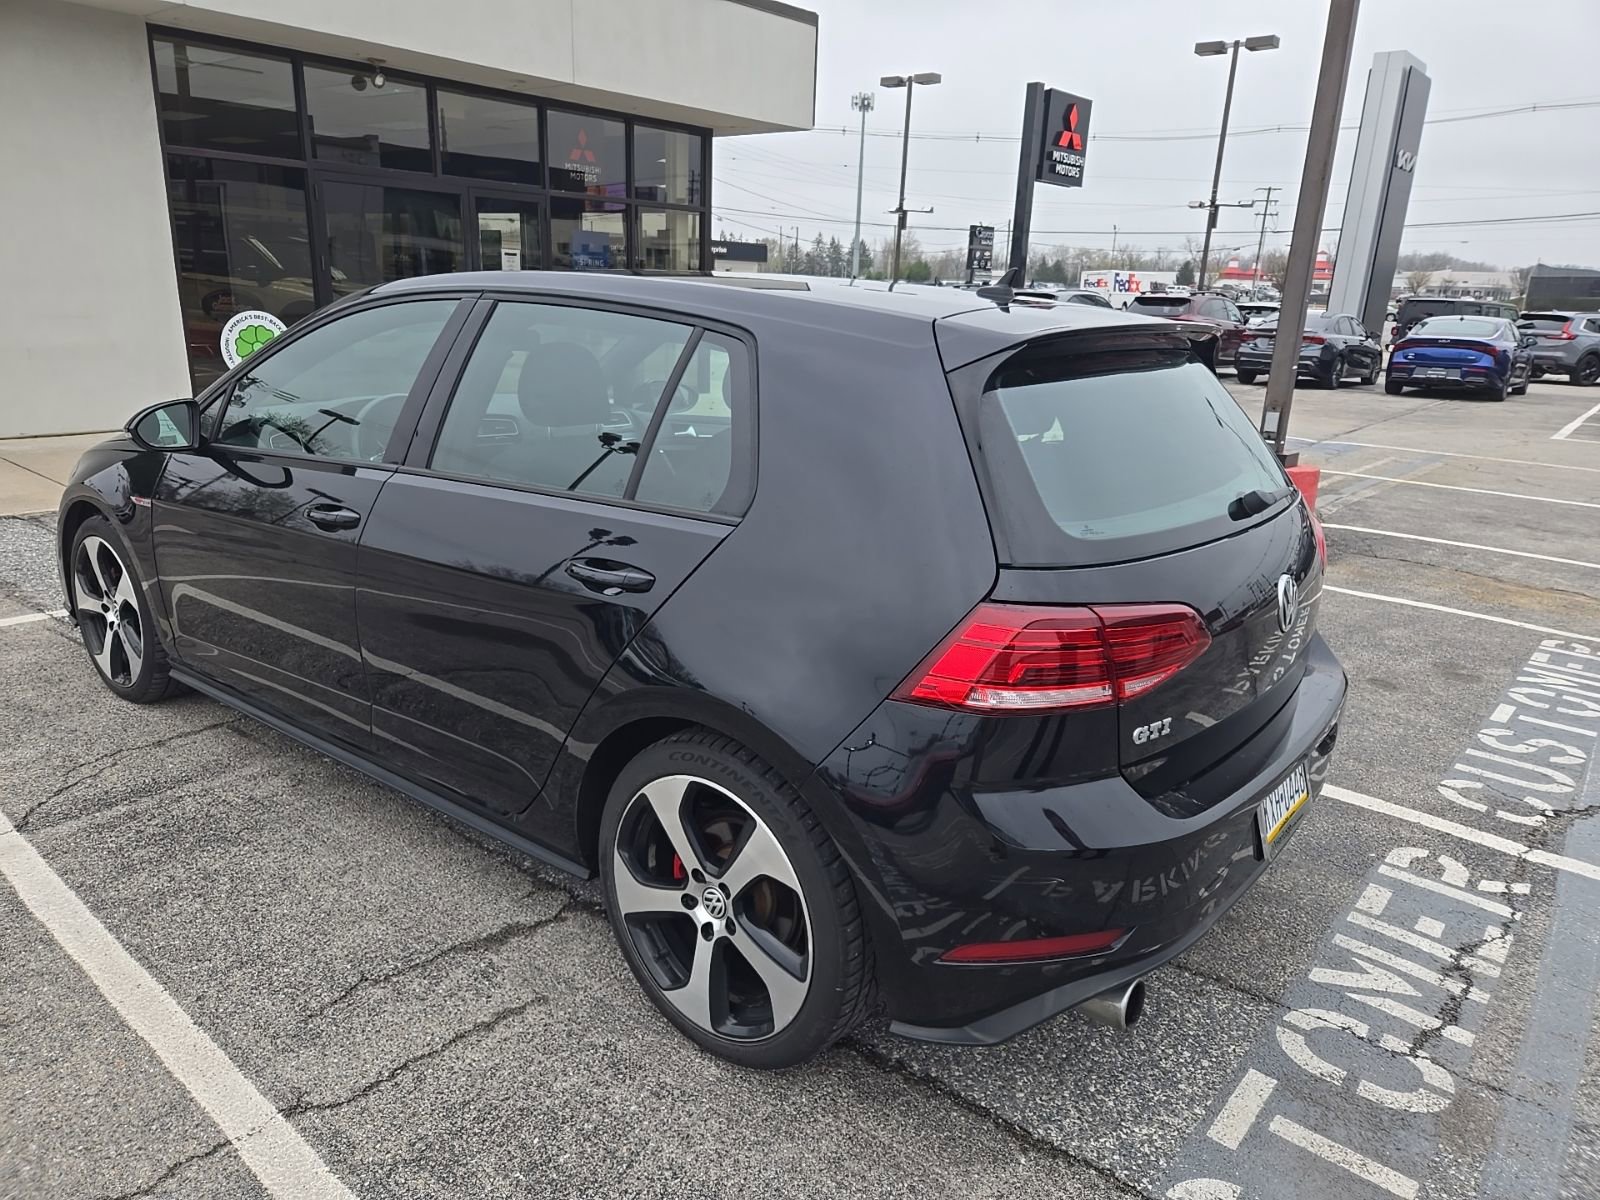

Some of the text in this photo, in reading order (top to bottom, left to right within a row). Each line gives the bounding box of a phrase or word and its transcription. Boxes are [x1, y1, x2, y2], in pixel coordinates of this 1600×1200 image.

[1052, 150, 1085, 167] MITSUBISHI
[564, 162, 601, 176] MITSUBISHI
[570, 171, 599, 183] MOTORS
[1055, 163, 1081, 178] MOTORS
[1084, 278, 1109, 289] FedEx
[1113, 272, 1142, 293] FedEx
[1132, 716, 1172, 745] GTI
[1437, 639, 1600, 827] CUSTOMER
[1165, 847, 1532, 1200] TOMER
